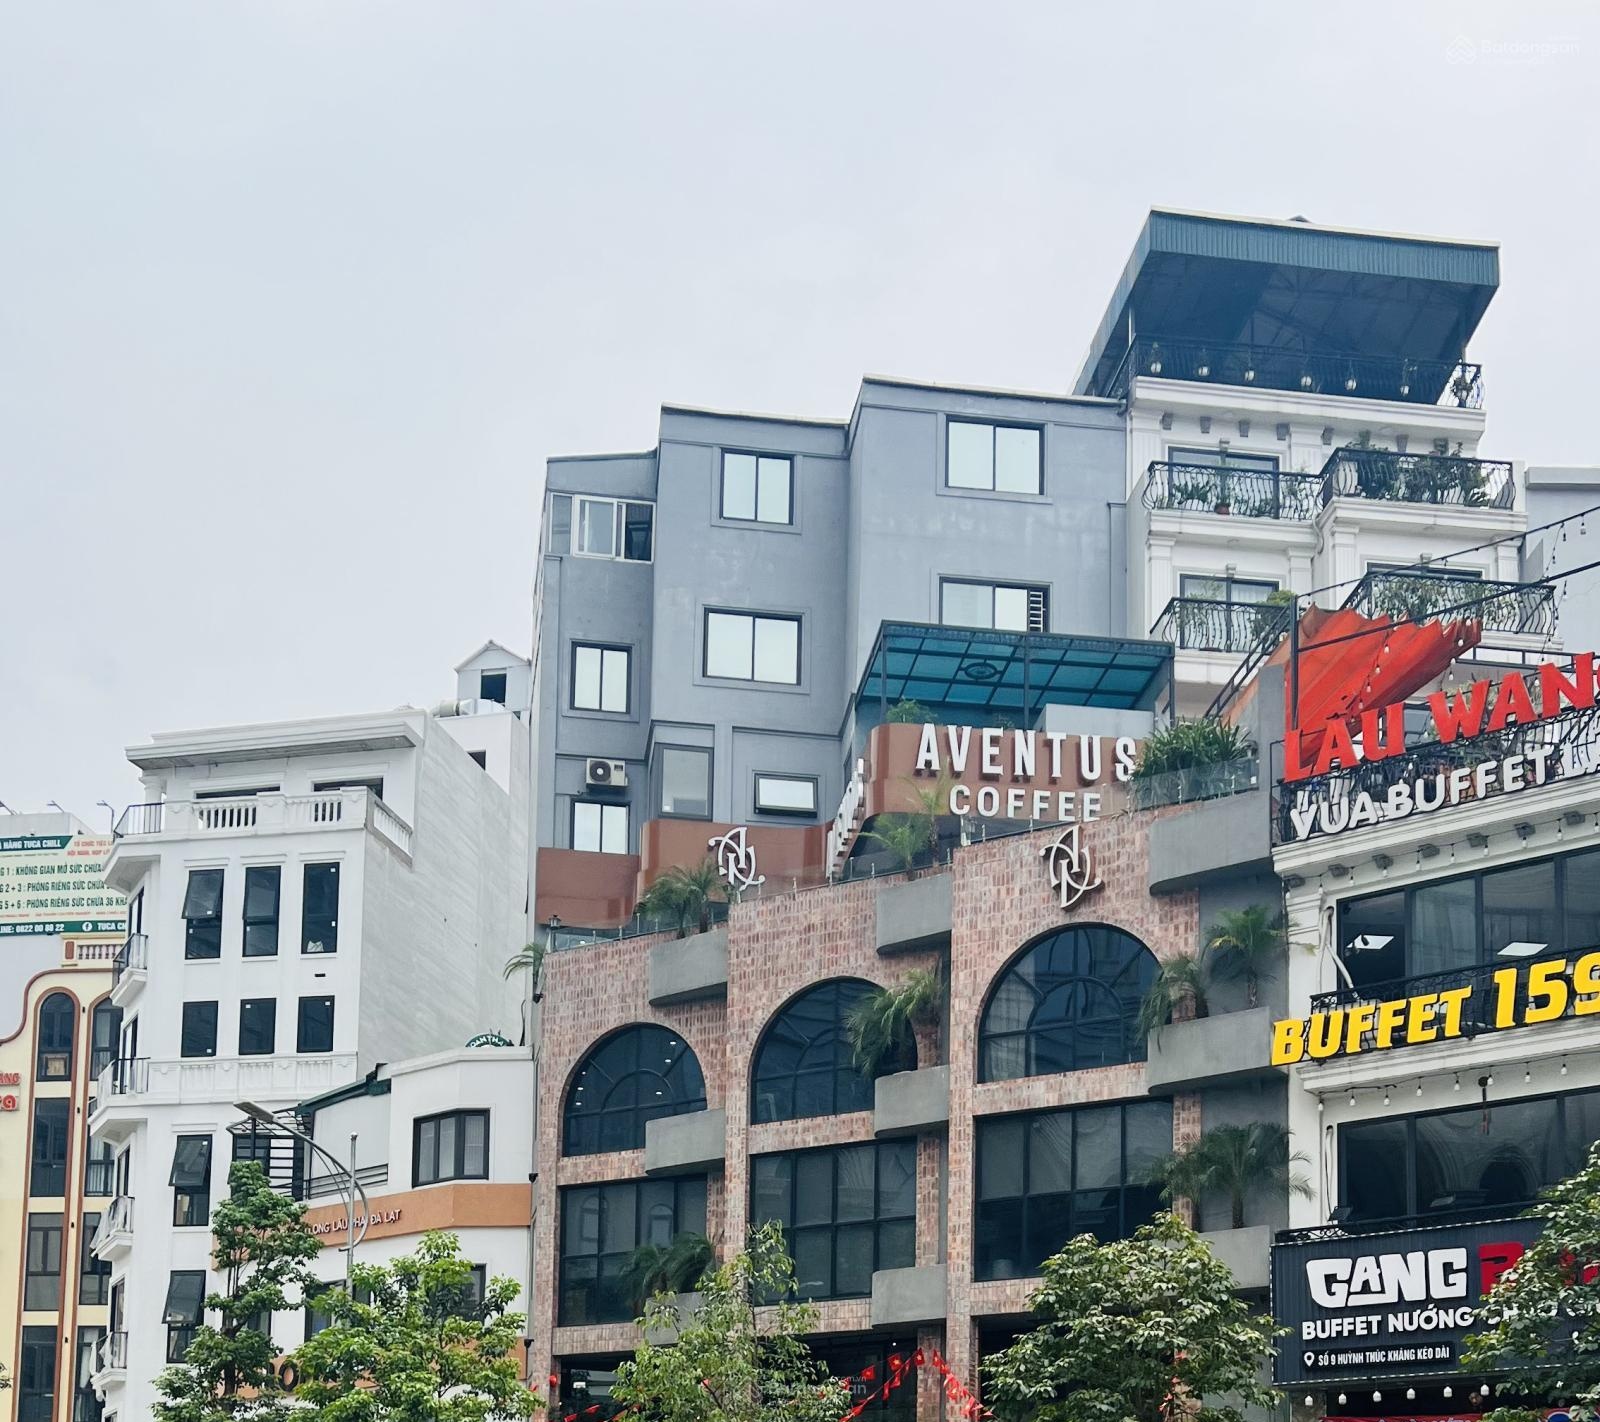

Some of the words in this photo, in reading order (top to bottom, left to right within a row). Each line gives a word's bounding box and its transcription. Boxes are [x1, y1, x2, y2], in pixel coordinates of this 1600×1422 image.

[1428, 652, 1600, 745] WAN
[915, 722, 1139, 782] AVENTUS
[948, 784, 1102, 822] COFFEE
[1289, 791, 1379, 840] VUA
[1387, 745, 1555, 818] BUFFET
[1271, 986, 1473, 1067] BUFFET
[1305, 1247, 1468, 1309] GANG
[1302, 1315, 1382, 1340] BUFFET
[1388, 1304, 1475, 1333] NƯỚNG
[1318, 1350, 1329, 1366] SỐ
[1330, 1354, 1336, 1365] 9
